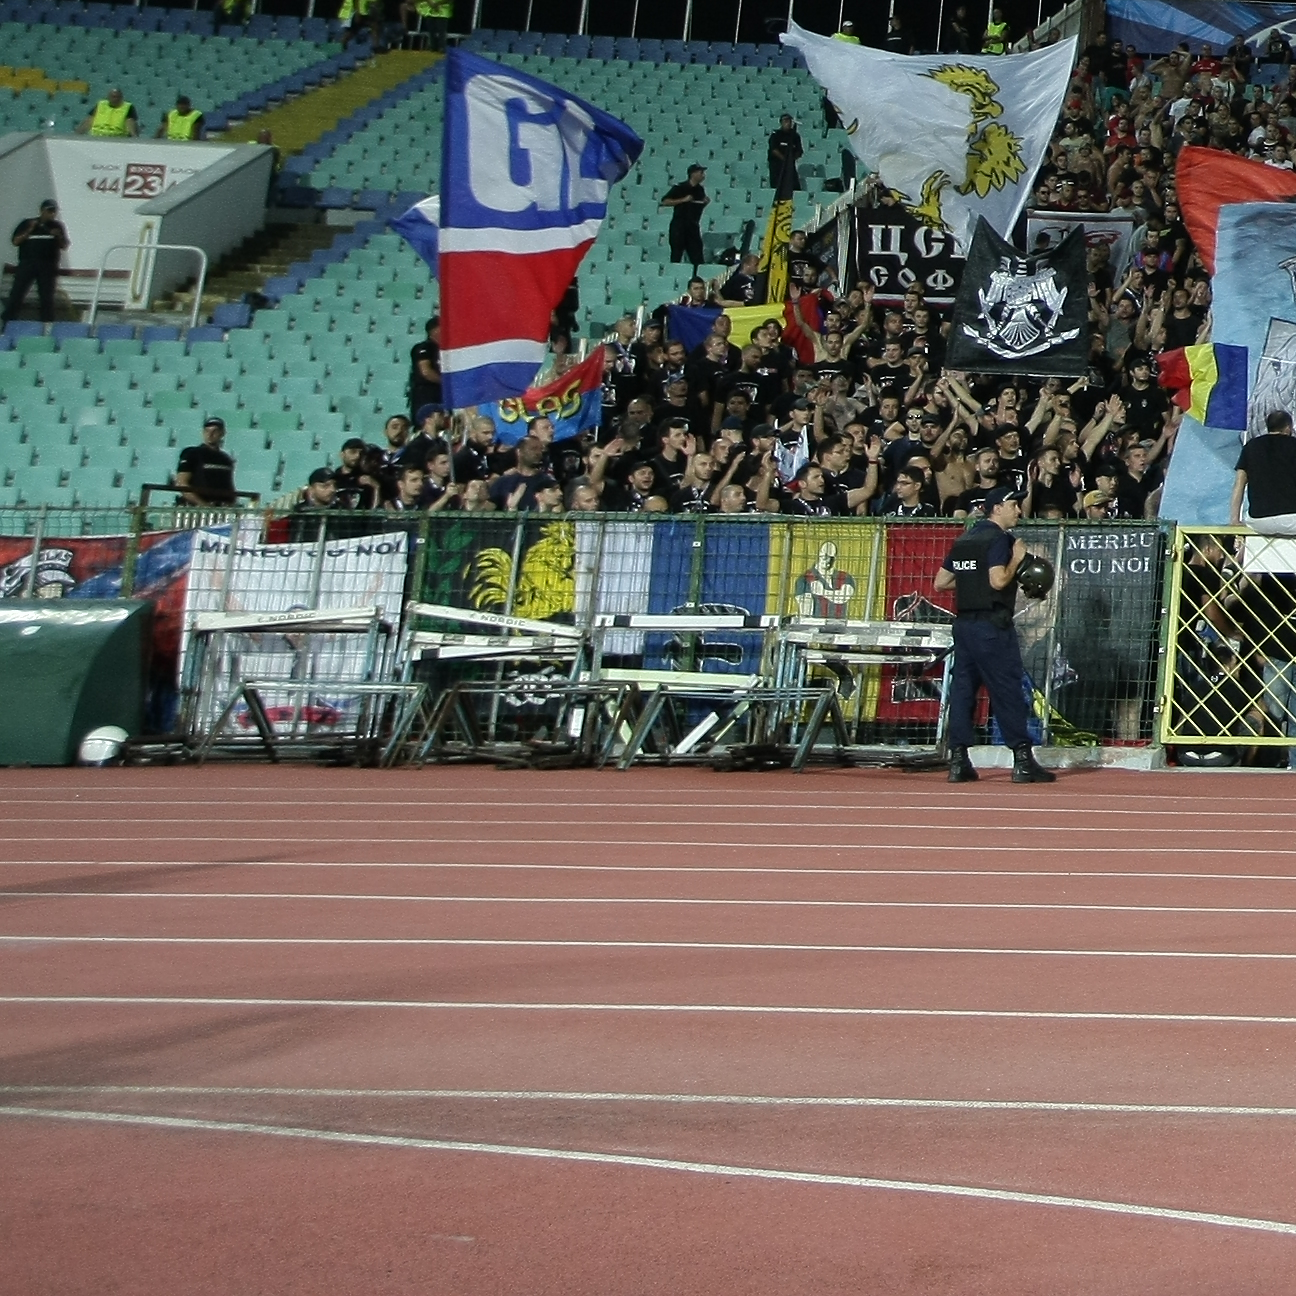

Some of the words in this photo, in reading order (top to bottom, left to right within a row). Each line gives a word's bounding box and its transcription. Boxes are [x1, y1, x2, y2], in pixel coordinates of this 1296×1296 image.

[124, 175, 162, 196] 23
[1066, 532, 1155, 550] MEREU
[1070, 558, 1101, 574] CU
[1110, 557, 1151, 573] NOI
